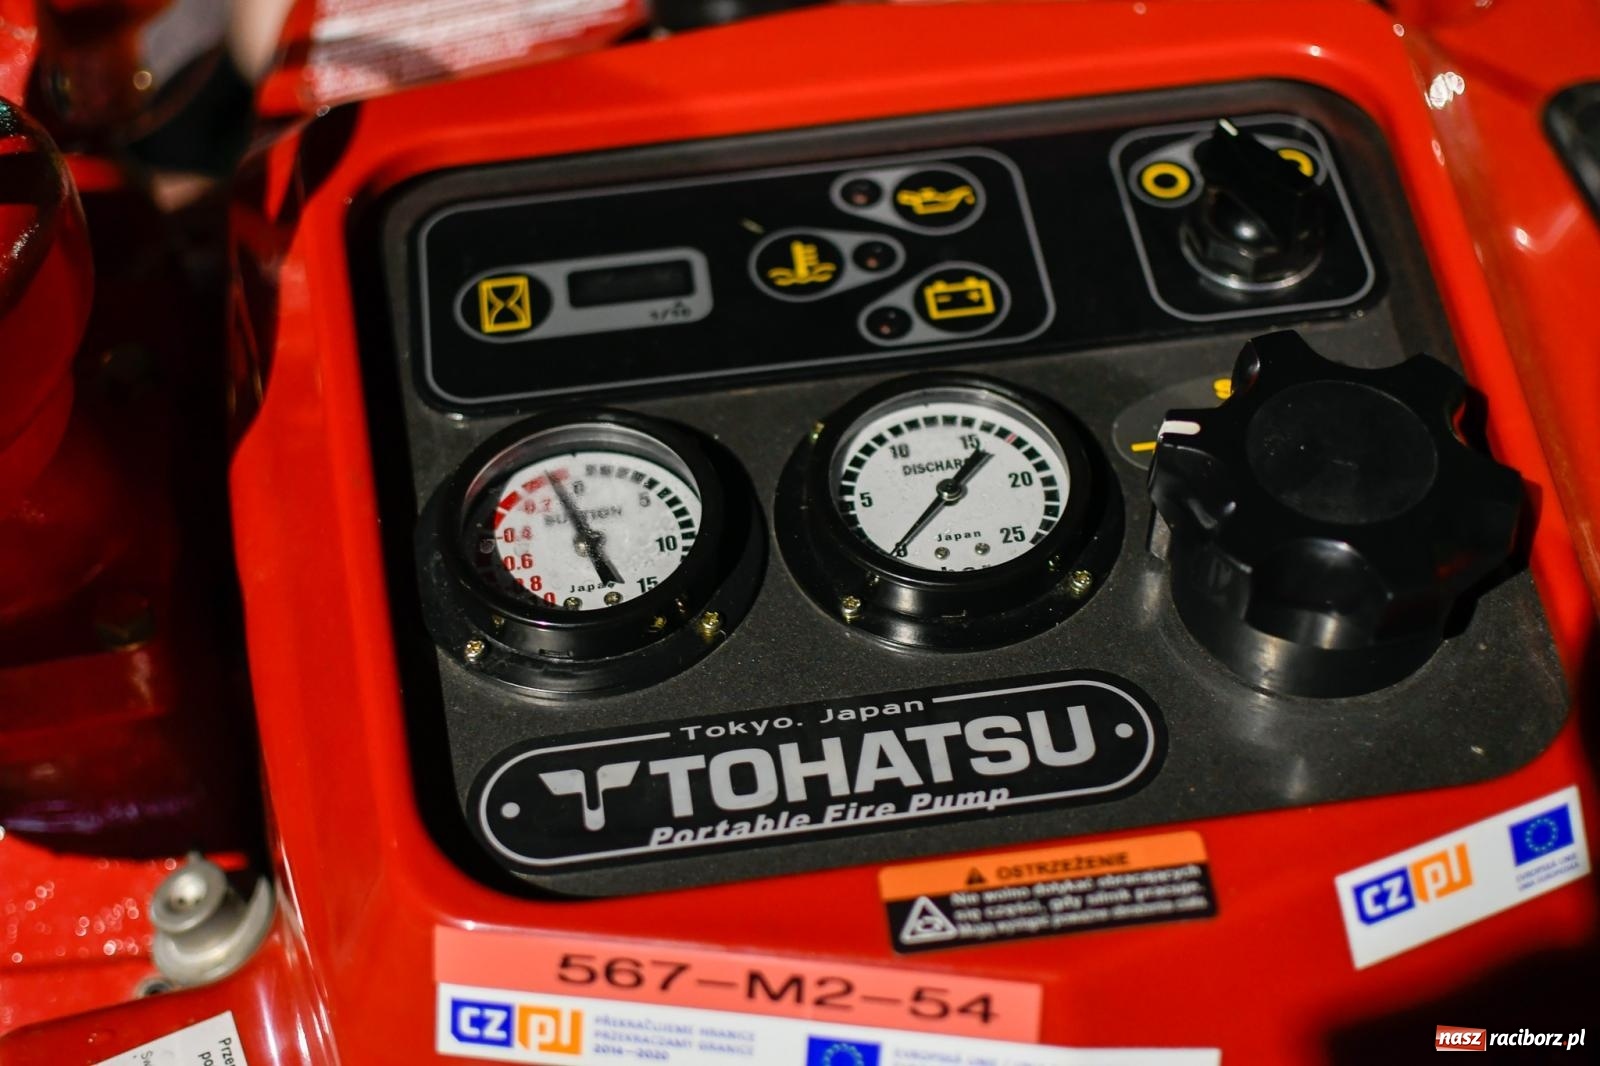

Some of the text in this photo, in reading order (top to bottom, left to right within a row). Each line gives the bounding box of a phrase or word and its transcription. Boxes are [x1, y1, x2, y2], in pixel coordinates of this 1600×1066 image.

[889, 443, 910, 459] 10
[960, 434, 981, 450] 15
[902, 457, 963, 476] DISCHAR
[1008, 470, 1034, 488] 20
[639, 491, 652, 508] 5
[860, 492, 874, 508] 5
[655, 535, 678, 553] 10
[936, 529, 982, 542] Japan
[999, 526, 1026, 544] 25
[503, 553, 533, 571] 0.6
[636, 576, 659, 593] 15
[819, 699, 925, 723] Japan
[648, 705, 1097, 819] TOHATSU
[649, 786, 1011, 850] Portable Fire Pump
[556, 953, 1000, 1025] 567-M2-54
